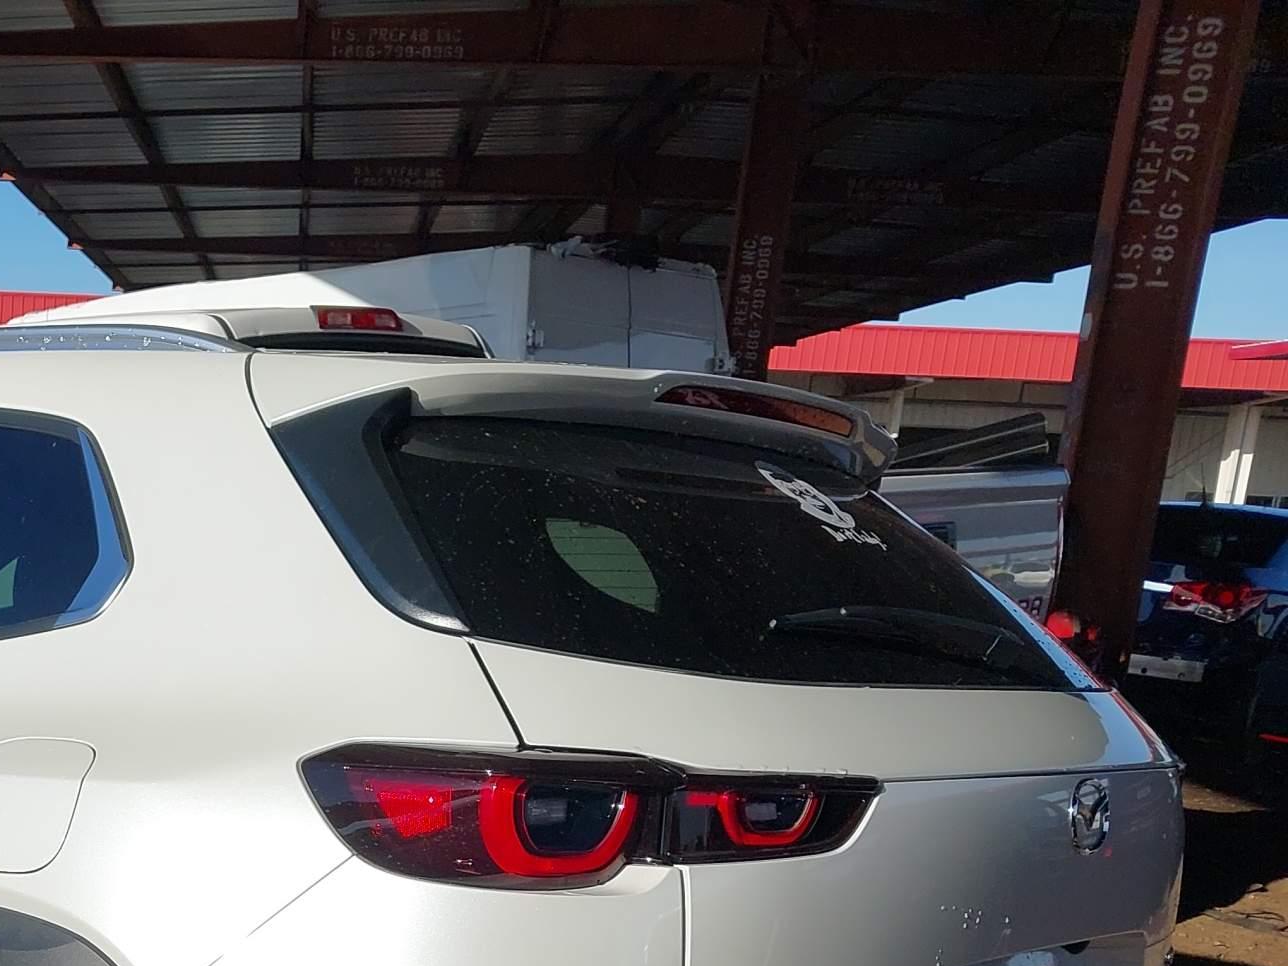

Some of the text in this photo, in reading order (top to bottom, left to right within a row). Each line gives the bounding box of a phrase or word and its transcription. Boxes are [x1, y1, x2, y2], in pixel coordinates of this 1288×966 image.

[1128, 94, 1174, 215] PREFAB
[1158, 15, 1194, 75] INC.
[1145, 17, 1225, 288] 1-866-799-0969
